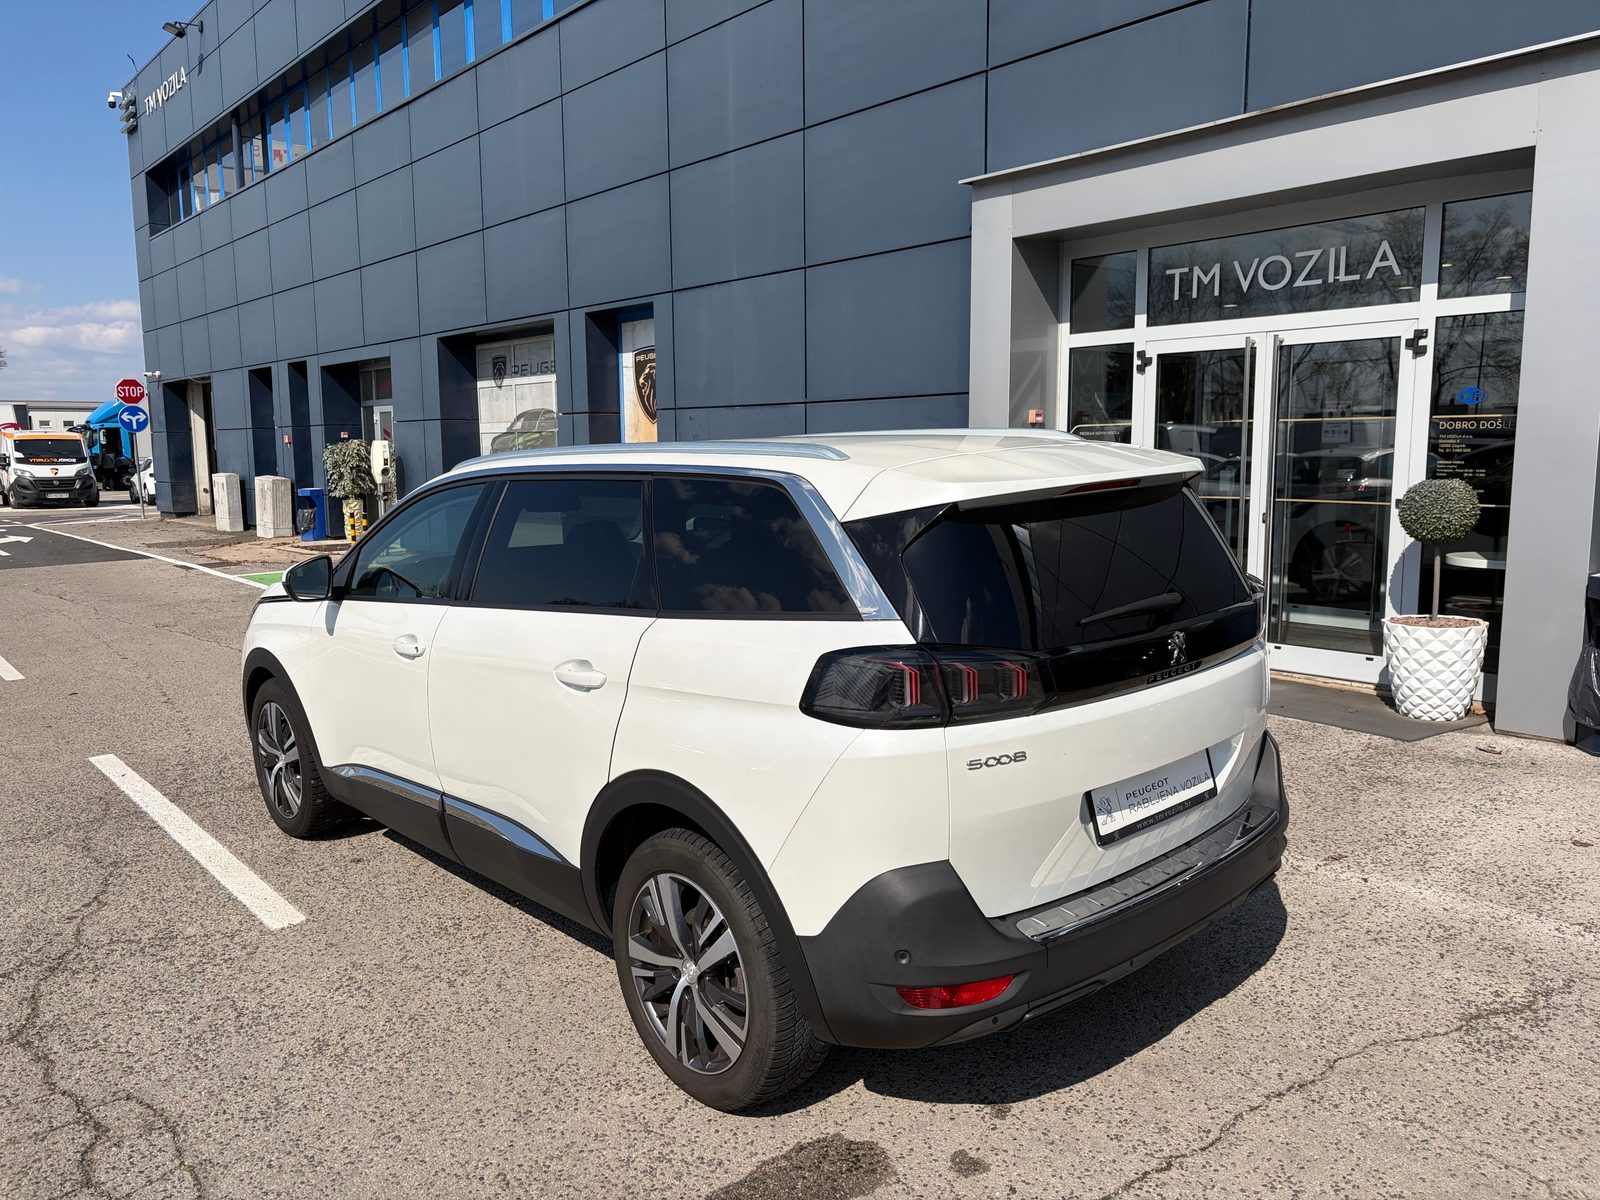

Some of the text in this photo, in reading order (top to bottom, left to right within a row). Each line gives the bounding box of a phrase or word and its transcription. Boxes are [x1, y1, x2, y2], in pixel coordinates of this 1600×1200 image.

[144, 66, 187, 115] TM VOZILA
[1166, 240, 1401, 301] TM VOZILA
[635, 352, 656, 362] PEUG
[117, 386, 144, 397] STOP
[1439, 421, 1477, 430] DOBRO
[1148, 663, 1197, 683] PEUGEOT
[967, 751, 1027, 770] 5008
[1125, 777, 1169, 801] PEUGEOT
[1128, 772, 1211, 814] RABLJENA VOZILA
